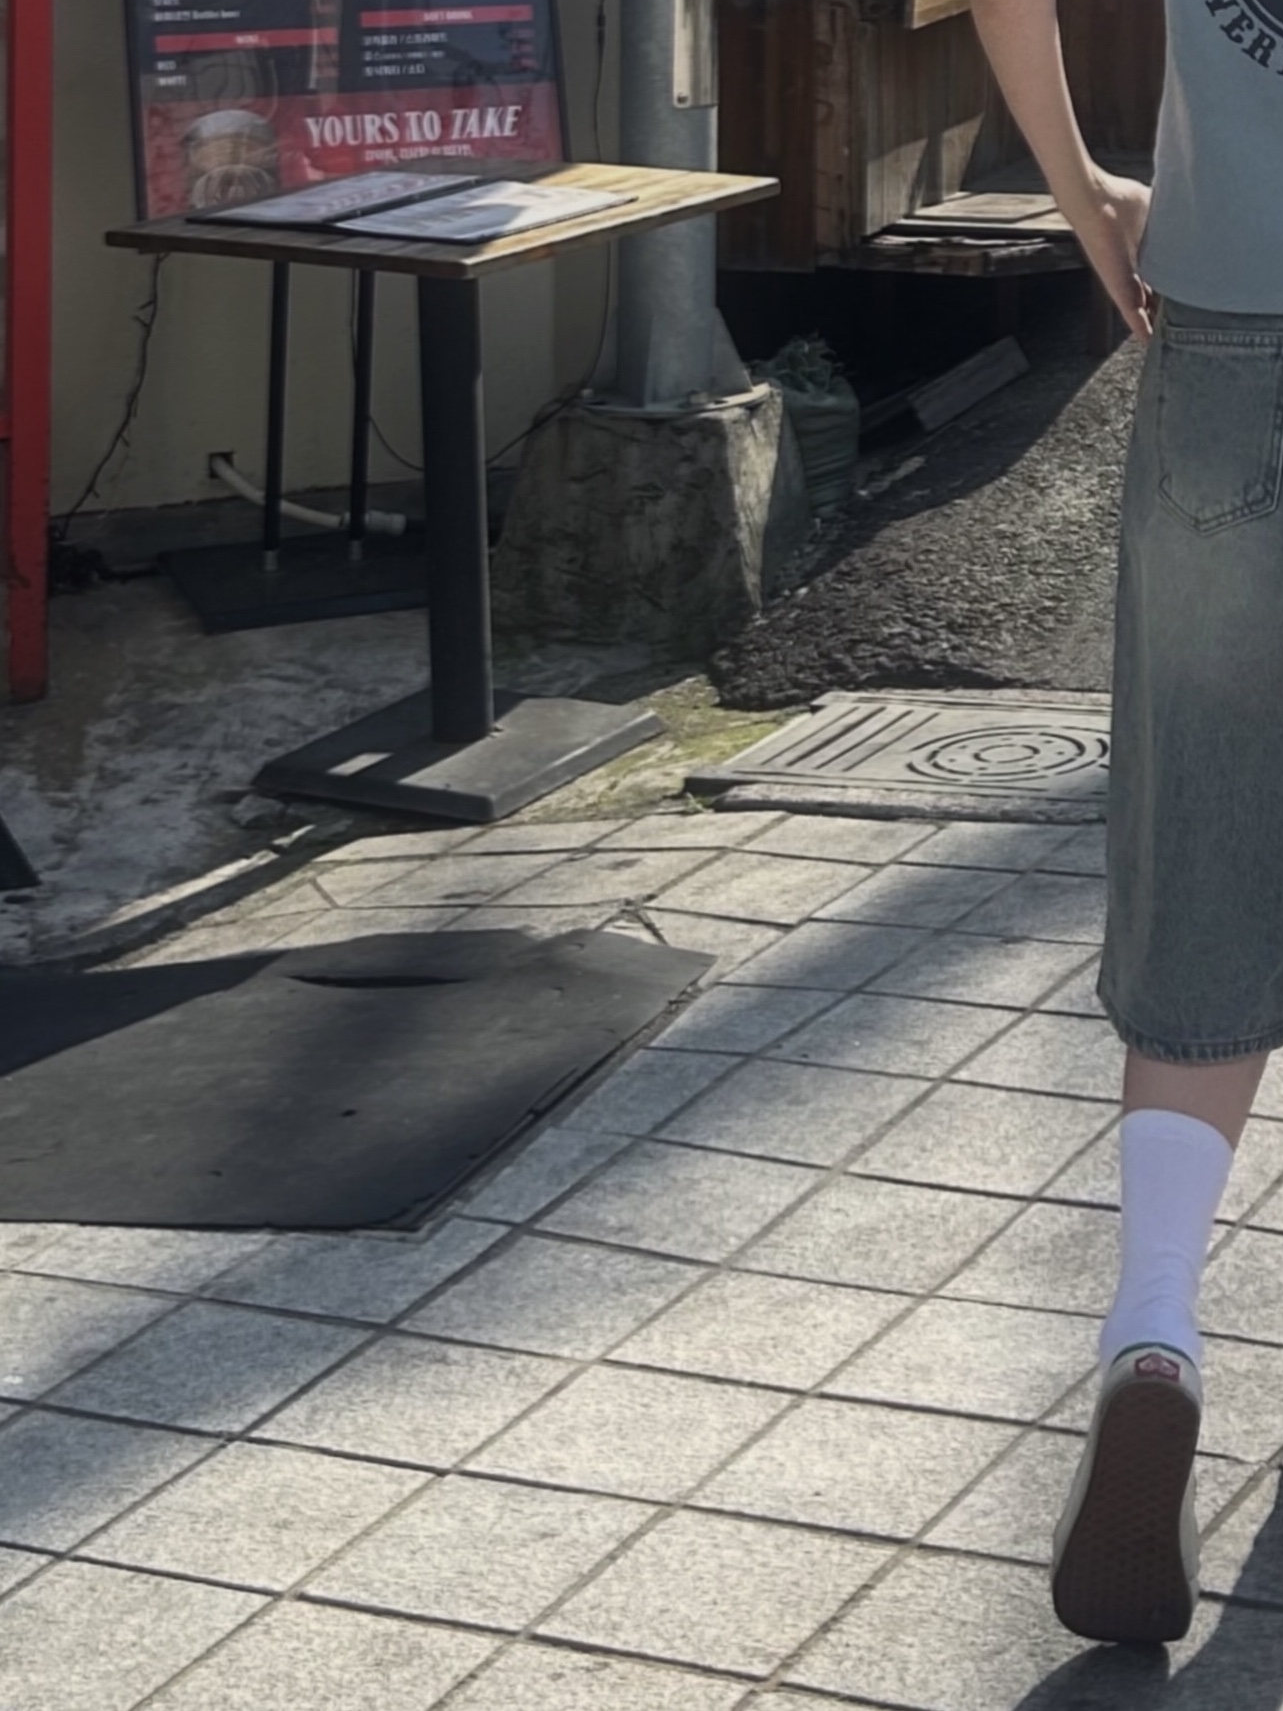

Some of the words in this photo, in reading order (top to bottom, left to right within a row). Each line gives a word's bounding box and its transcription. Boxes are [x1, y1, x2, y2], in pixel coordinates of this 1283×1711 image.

[304, 112, 399, 149] YOURS
[405, 110, 442, 143] TO
[450, 105, 523, 140] TAKE
